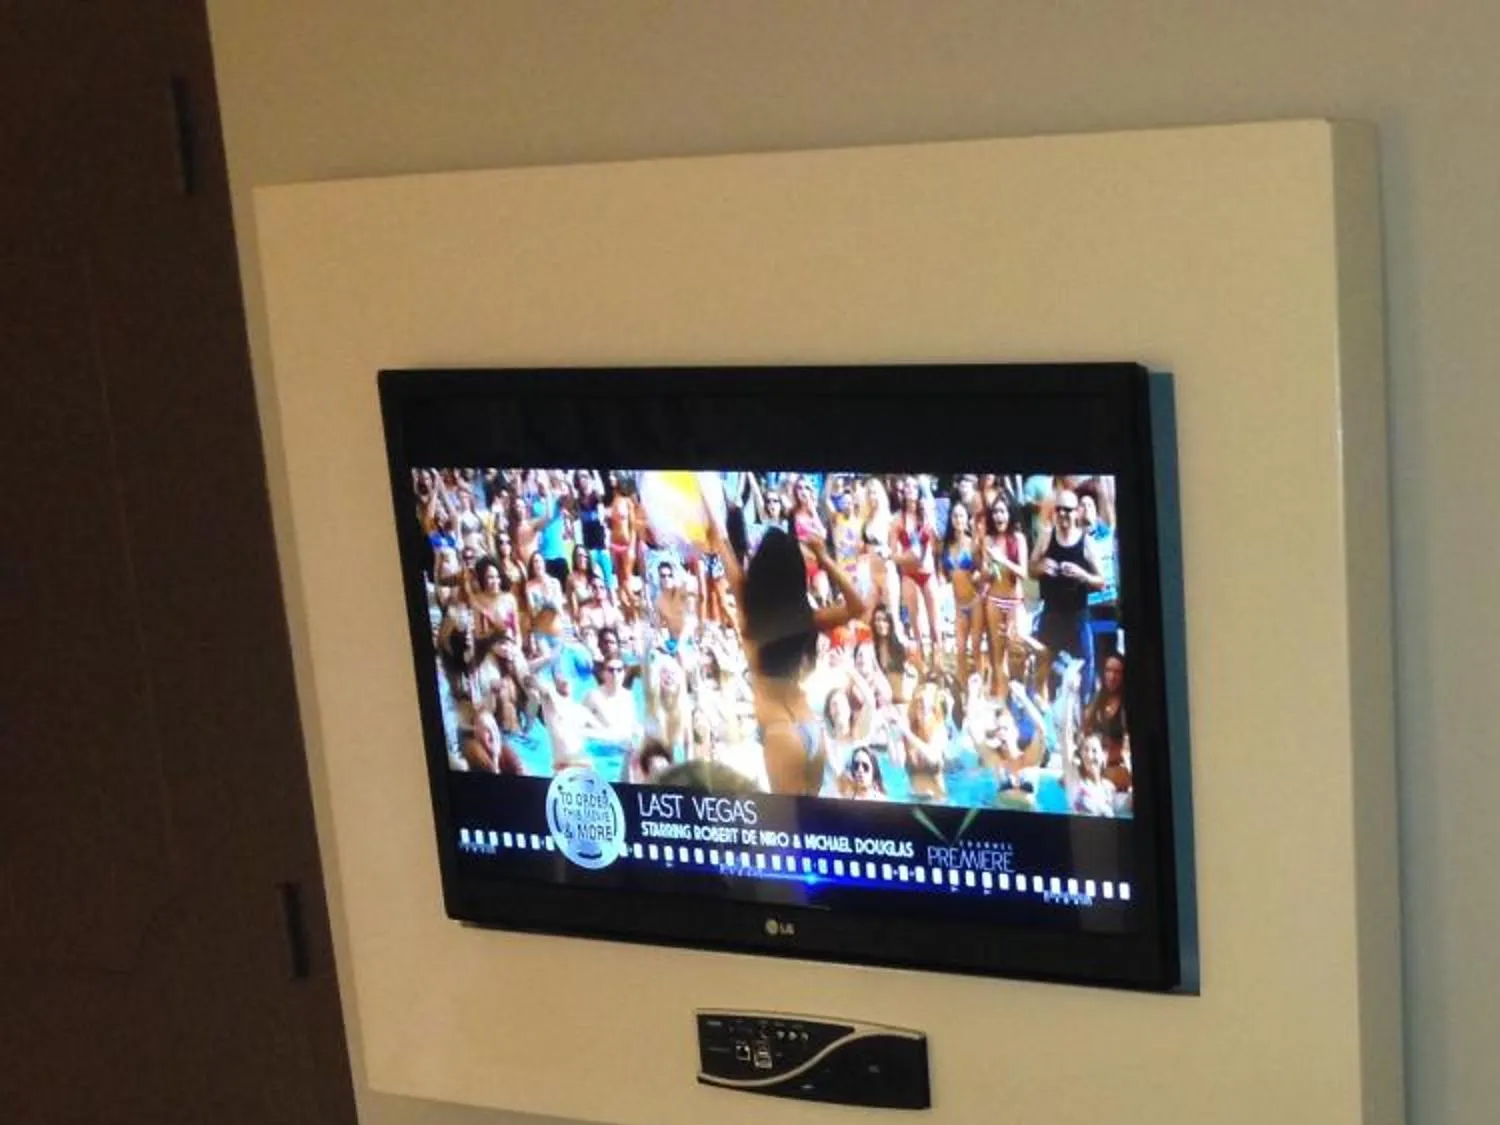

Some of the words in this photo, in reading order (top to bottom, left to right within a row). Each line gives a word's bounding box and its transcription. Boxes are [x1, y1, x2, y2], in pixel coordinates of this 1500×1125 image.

[560, 791, 573, 806] TO
[637, 791, 684, 819] LAST
[692, 795, 758, 824] VEGAS
[577, 824, 613, 842] MORE
[641, 821, 692, 840] STARRING
[694, 826, 739, 845] ROBERT
[742, 829, 758, 846] DE
[760, 830, 789, 848] NIRO
[792, 833, 801, 849] &
[804, 834, 852, 854] MICHAEL
[854, 837, 914, 858] DOUGLAS
[927, 845, 1015, 873] PREMIERE
